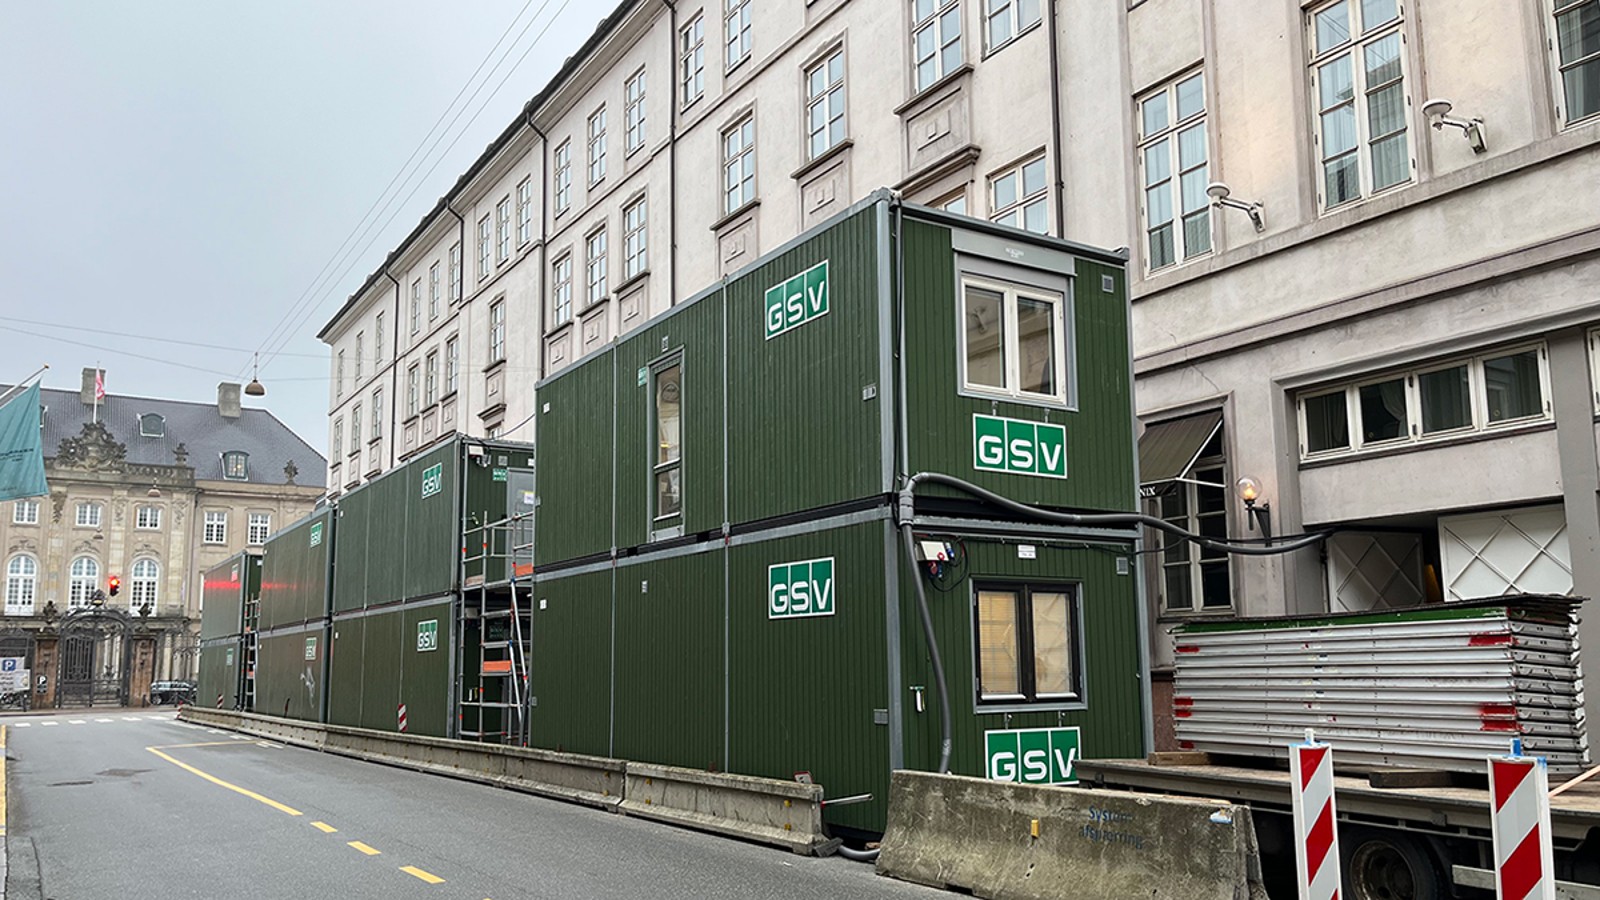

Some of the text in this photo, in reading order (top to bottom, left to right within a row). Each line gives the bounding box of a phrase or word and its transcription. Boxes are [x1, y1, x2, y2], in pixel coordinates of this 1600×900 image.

[768, 281, 825, 331] GSV
[978, 435, 1062, 471] GSV
[422, 473, 442, 495] GSV
[771, 578, 831, 613] GSV
[418, 630, 437, 648] GSV
[992, 748, 1076, 782] GSV
